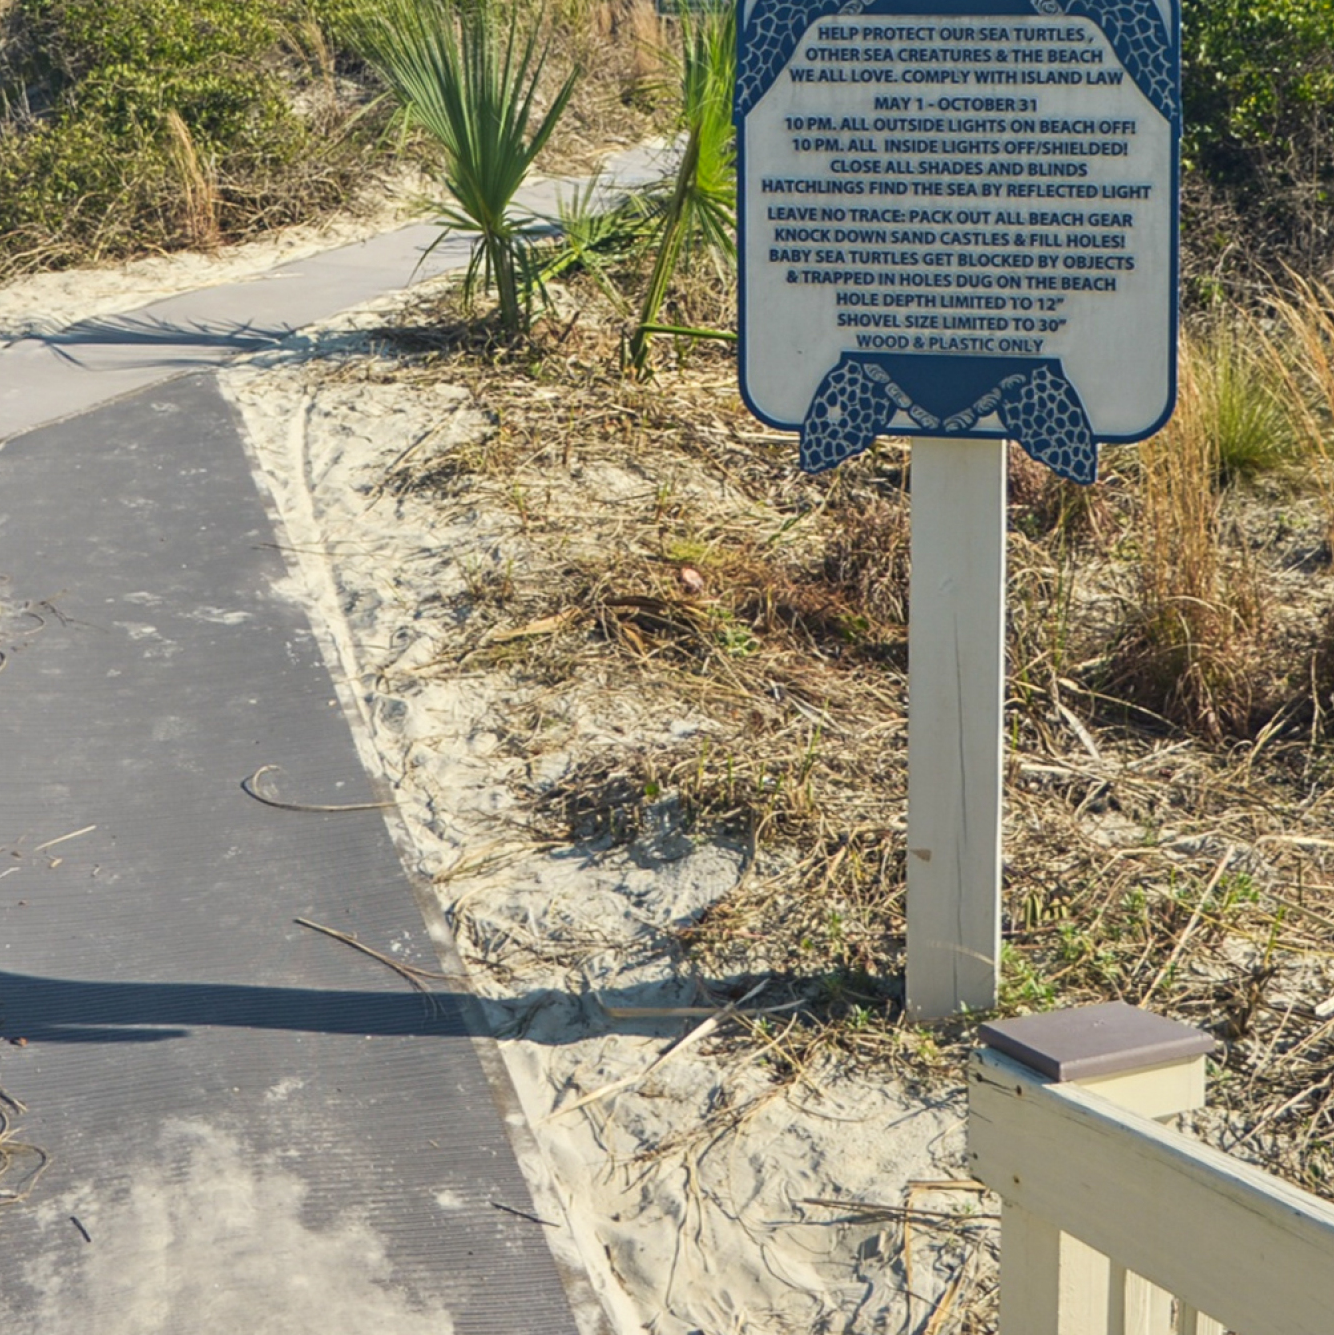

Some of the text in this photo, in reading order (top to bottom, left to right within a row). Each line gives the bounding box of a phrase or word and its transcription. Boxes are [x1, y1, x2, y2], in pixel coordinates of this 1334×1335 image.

[817, 27, 859, 41] HELP
[863, 27, 936, 41] PROTECT
[940, 28, 975, 41] OUR
[979, 28, 1010, 42] SEA
[805, 48, 1104, 64] OTHER SEA CREATURES & THE BEACH
[789, 69, 1123, 85] WE ALL LOVE. COMPLY WITH ISLAND LAW
[874, 97, 912, 111] MAY
[914, 98, 924, 111] 1
[937, 98, 1015, 112] OCTOBER
[1018, 99, 1038, 112] 31
[785, 118, 1136, 135] 10 PM. ALL OUTSIDE LIGHTS ON BEACH OFF!
[792, 138, 1129, 156] 10 PM. ALL INSIDE LIGHTS OFF/SHIELDED!
[830, 160, 1089, 177] CLOSE ALL SHADES AND BLINDS
[761, 180, 1152, 199] HATCHLINGS FIND THE SEA BY REFLECTED LIGHT
[767, 207, 1133, 227] LEAVE NO TRACE: PACK OUT ALL BEACH GEAR
[774, 229, 1126, 249] KNOCK DOWN SAND CASTLES & FILL HOLES!
[769, 249, 1136, 270] BABY SEA TURTLES GET BLOCKED BY OBJECTS
[786, 271, 1116, 291] & TRAPPED IN HOLES DUG ON THE BEACH
[836, 293, 879, 306] HOLE
[882, 294, 937, 307] DEPTH
[939, 295, 1006, 310] LIMITED
[1009, 297, 1033, 310] TO
[837, 313, 902, 328] SHOVEL
[905, 315, 939, 329] SIZE
[942, 316, 1009, 331] LIMITED
[1011, 318, 1036, 331] TO
[856, 335, 1044, 353] WOOD & PLASTIC ONLY
